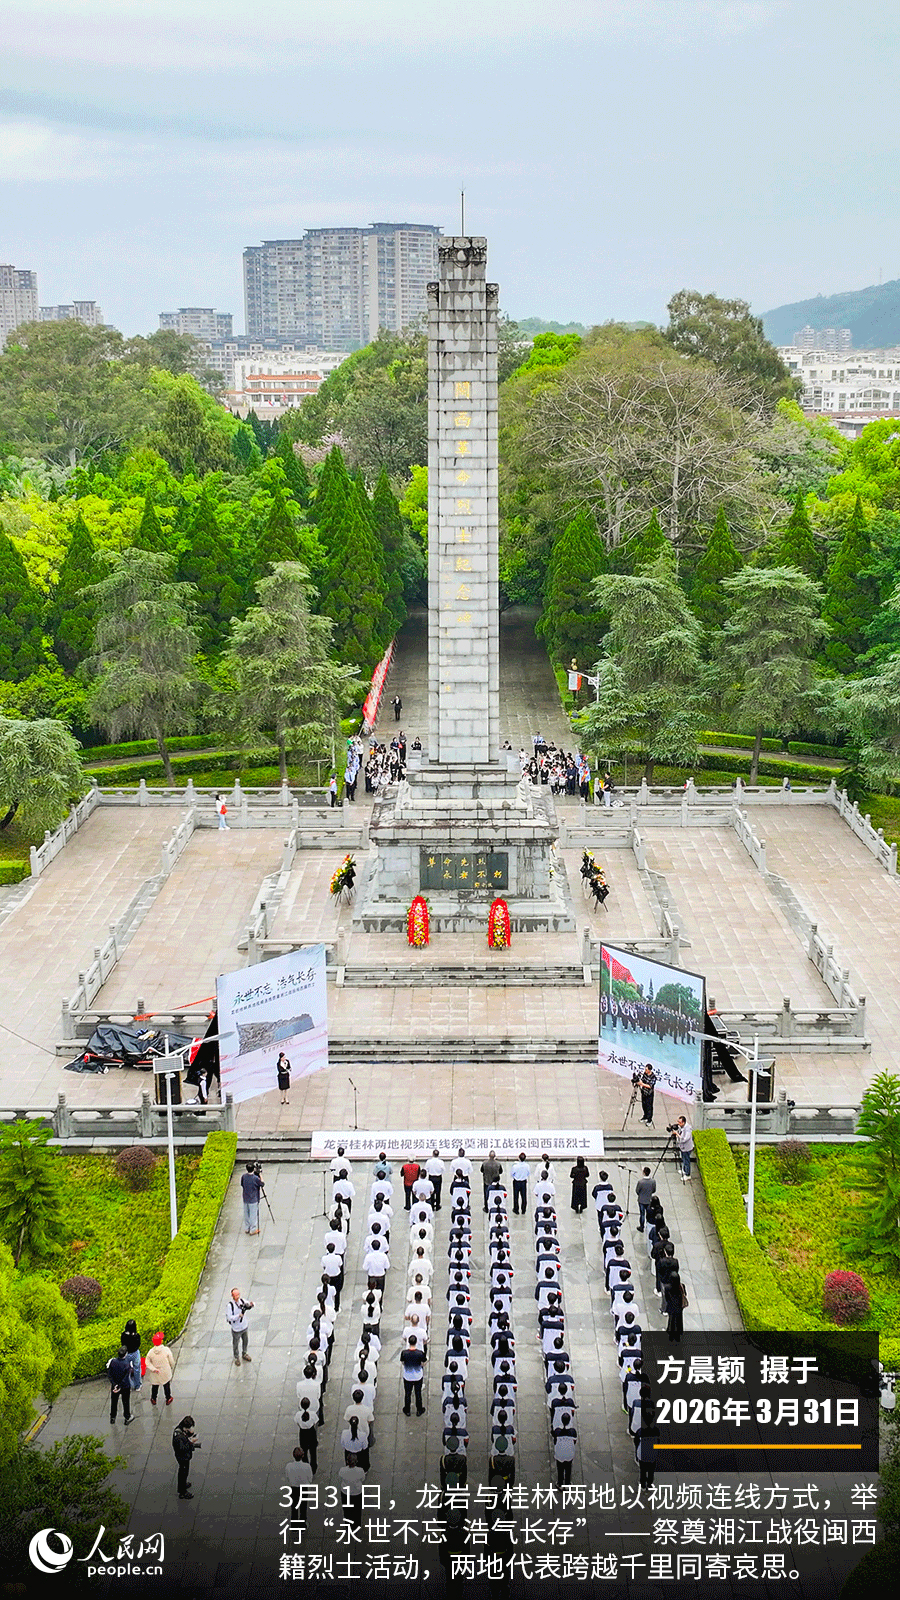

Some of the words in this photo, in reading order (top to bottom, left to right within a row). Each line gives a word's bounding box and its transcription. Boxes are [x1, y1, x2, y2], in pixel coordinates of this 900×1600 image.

[232, 982, 273, 1008] 永世不忘
[276, 967, 317, 991] 浩气长存
